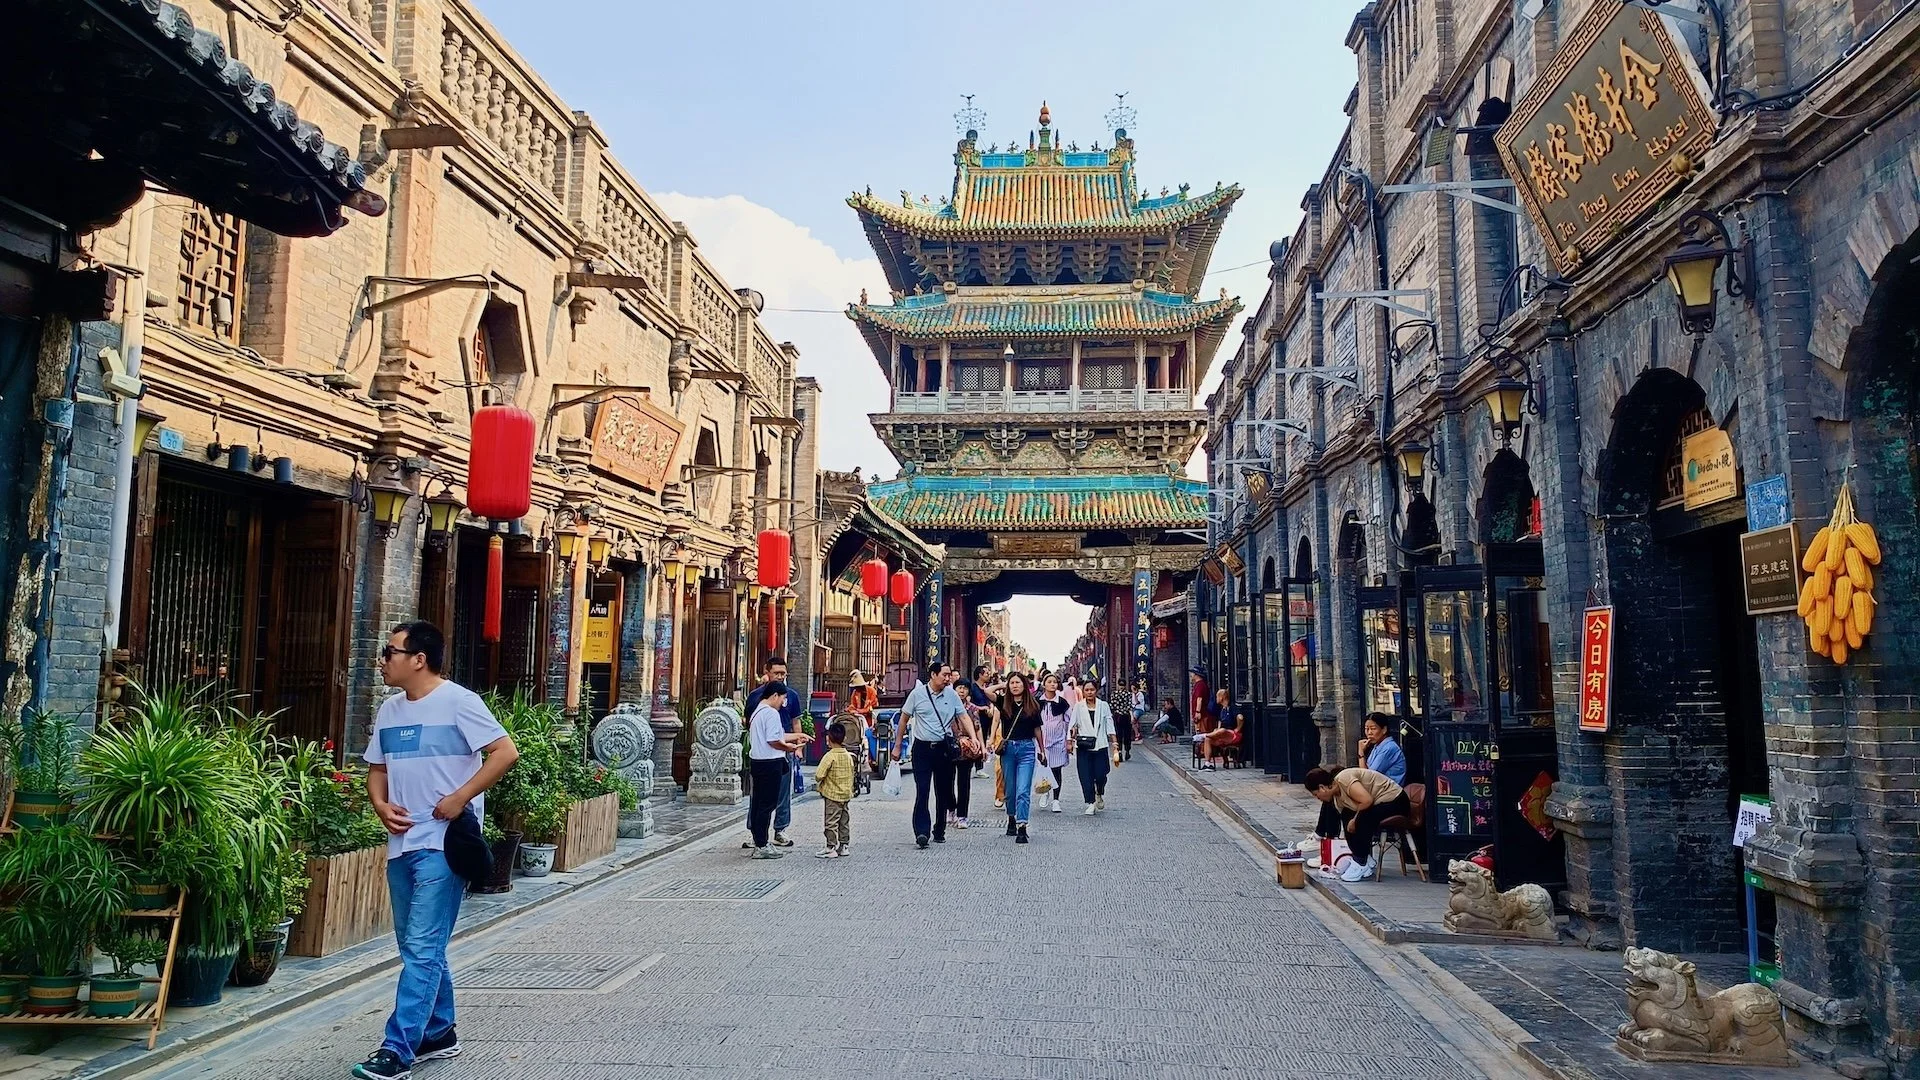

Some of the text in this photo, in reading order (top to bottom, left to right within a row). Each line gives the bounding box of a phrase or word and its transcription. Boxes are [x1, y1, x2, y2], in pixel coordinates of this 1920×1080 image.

[1557, 115, 1690, 241] Jin Jing Lou Hotel
[1750, 560, 1789, 576] 历史建筑
[927, 579, 939, 668] 百尺樓高物
[1585, 616, 1607, 722] 今日有房
[1457, 740, 1480, 755] DIY
